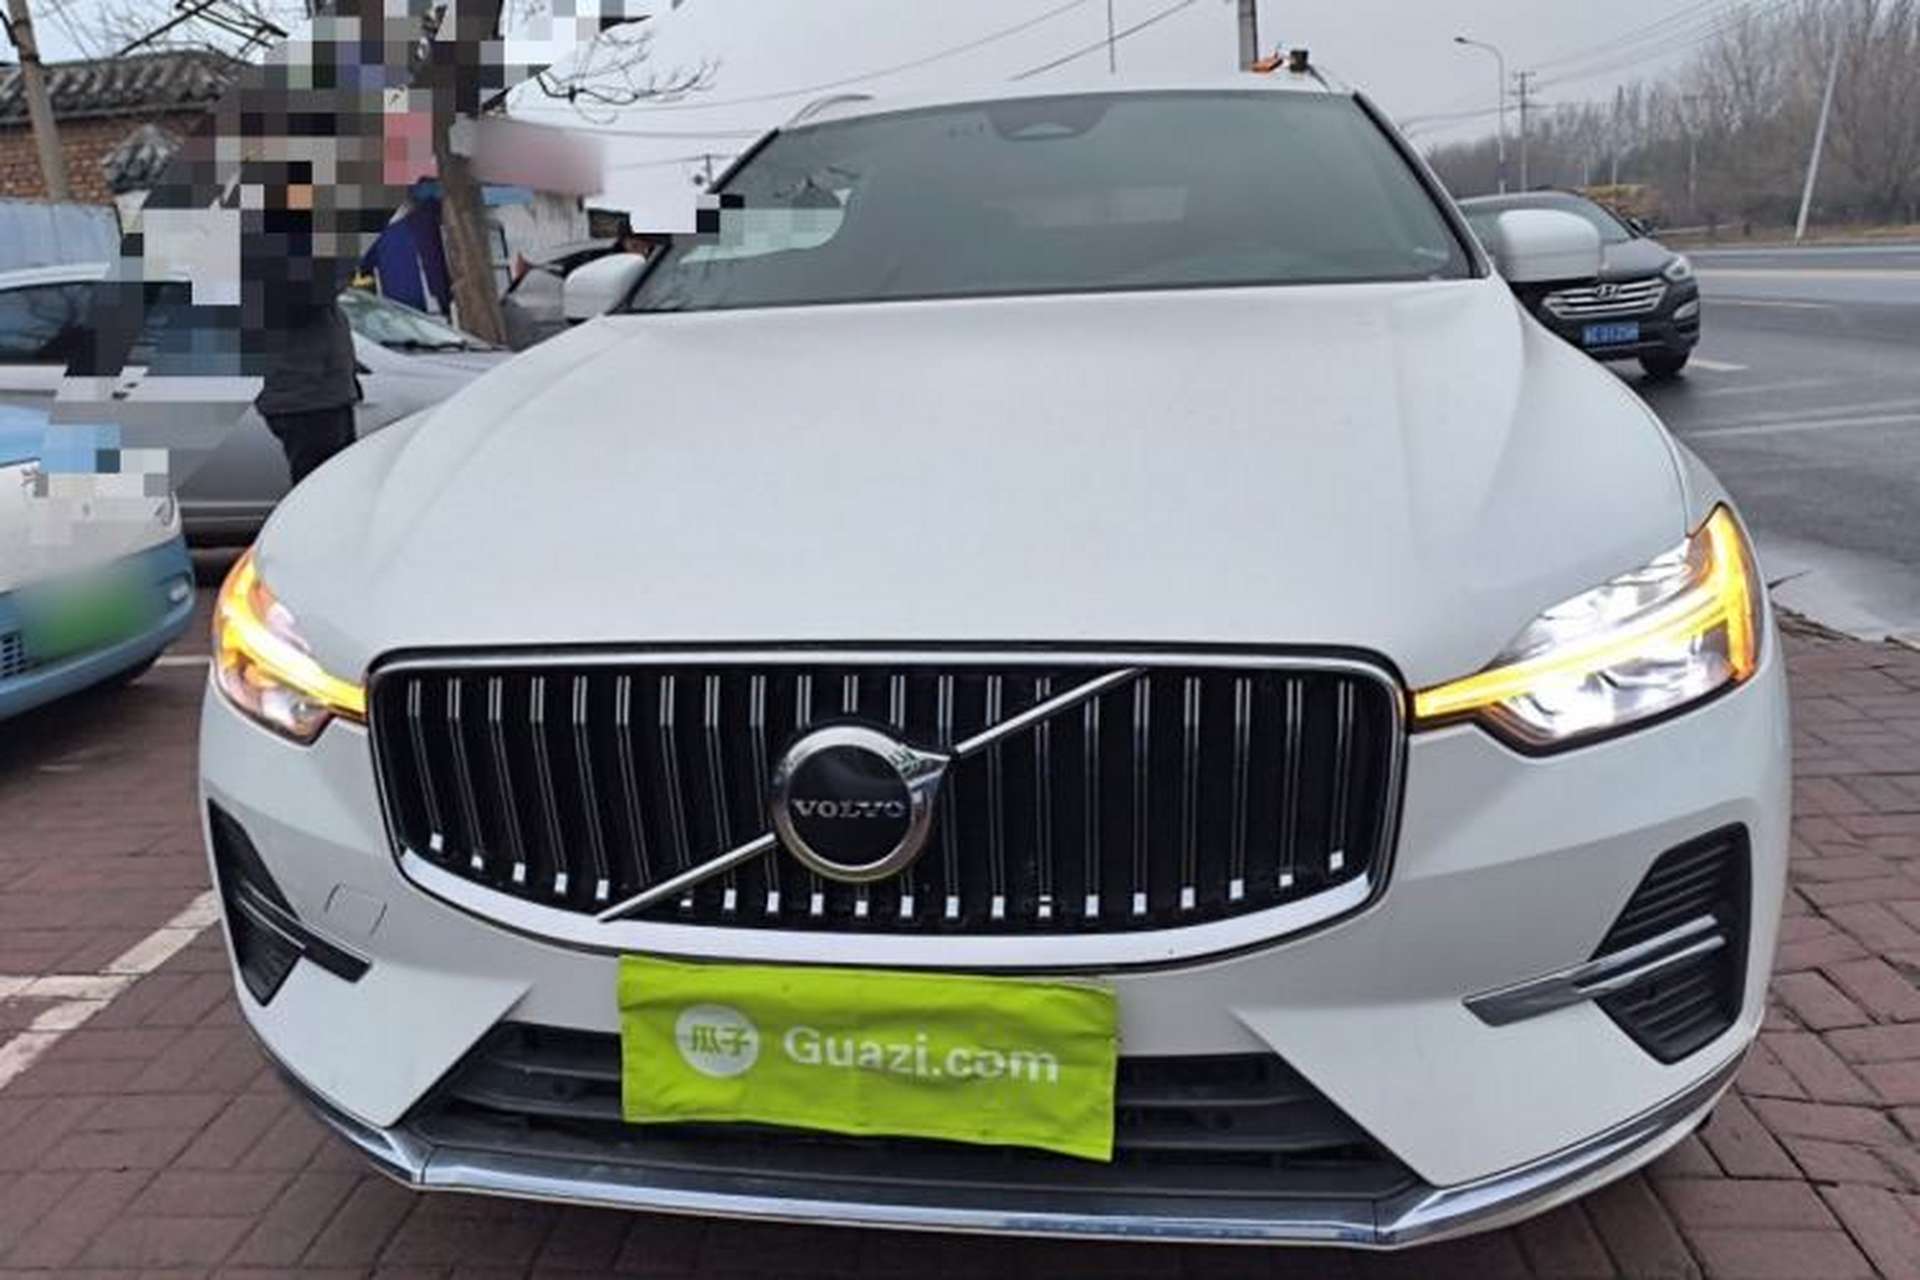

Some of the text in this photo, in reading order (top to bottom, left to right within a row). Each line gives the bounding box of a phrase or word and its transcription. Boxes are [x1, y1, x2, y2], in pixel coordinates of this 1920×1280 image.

[793, 799, 906, 818] VOLVO
[691, 1023, 752, 1057] 瓜子
[783, 1026, 1059, 1083] Guazi.com
